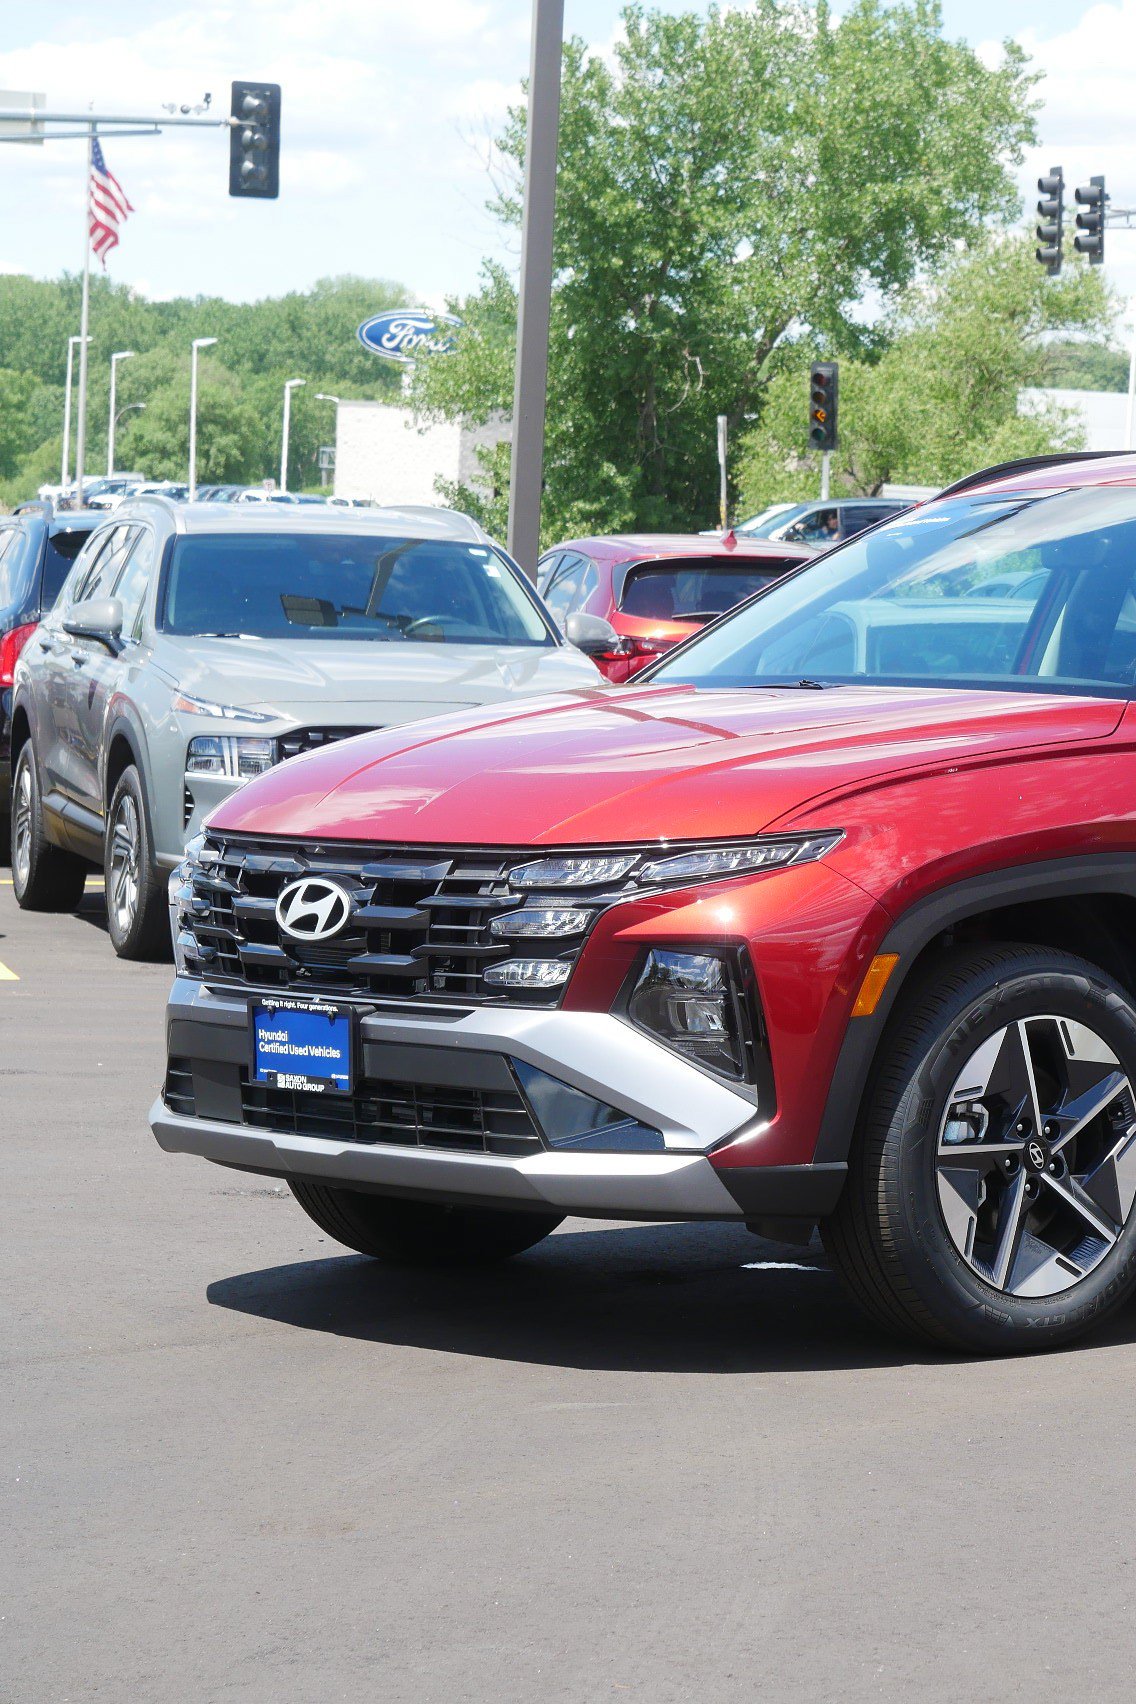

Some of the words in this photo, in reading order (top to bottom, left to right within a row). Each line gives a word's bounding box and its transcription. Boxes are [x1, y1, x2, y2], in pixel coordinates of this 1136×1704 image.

[262, 999, 279, 1007] Getting
[284, 1001, 296, 1009] right.
[296, 1002, 308, 1010] Four
[309, 1004, 338, 1012] generations.
[948, 976, 1054, 1057] NEXEN
[258, 1029, 288, 1042] Hyundai
[259, 1042, 288, 1054] Certified
[289, 1044, 308, 1056] Used
[308, 1045, 341, 1059] Vehicles
[285, 1073, 307, 1083] SAXON
[284, 1081, 302, 1090] AUTO
[302, 1081, 325, 1092] GROUP
